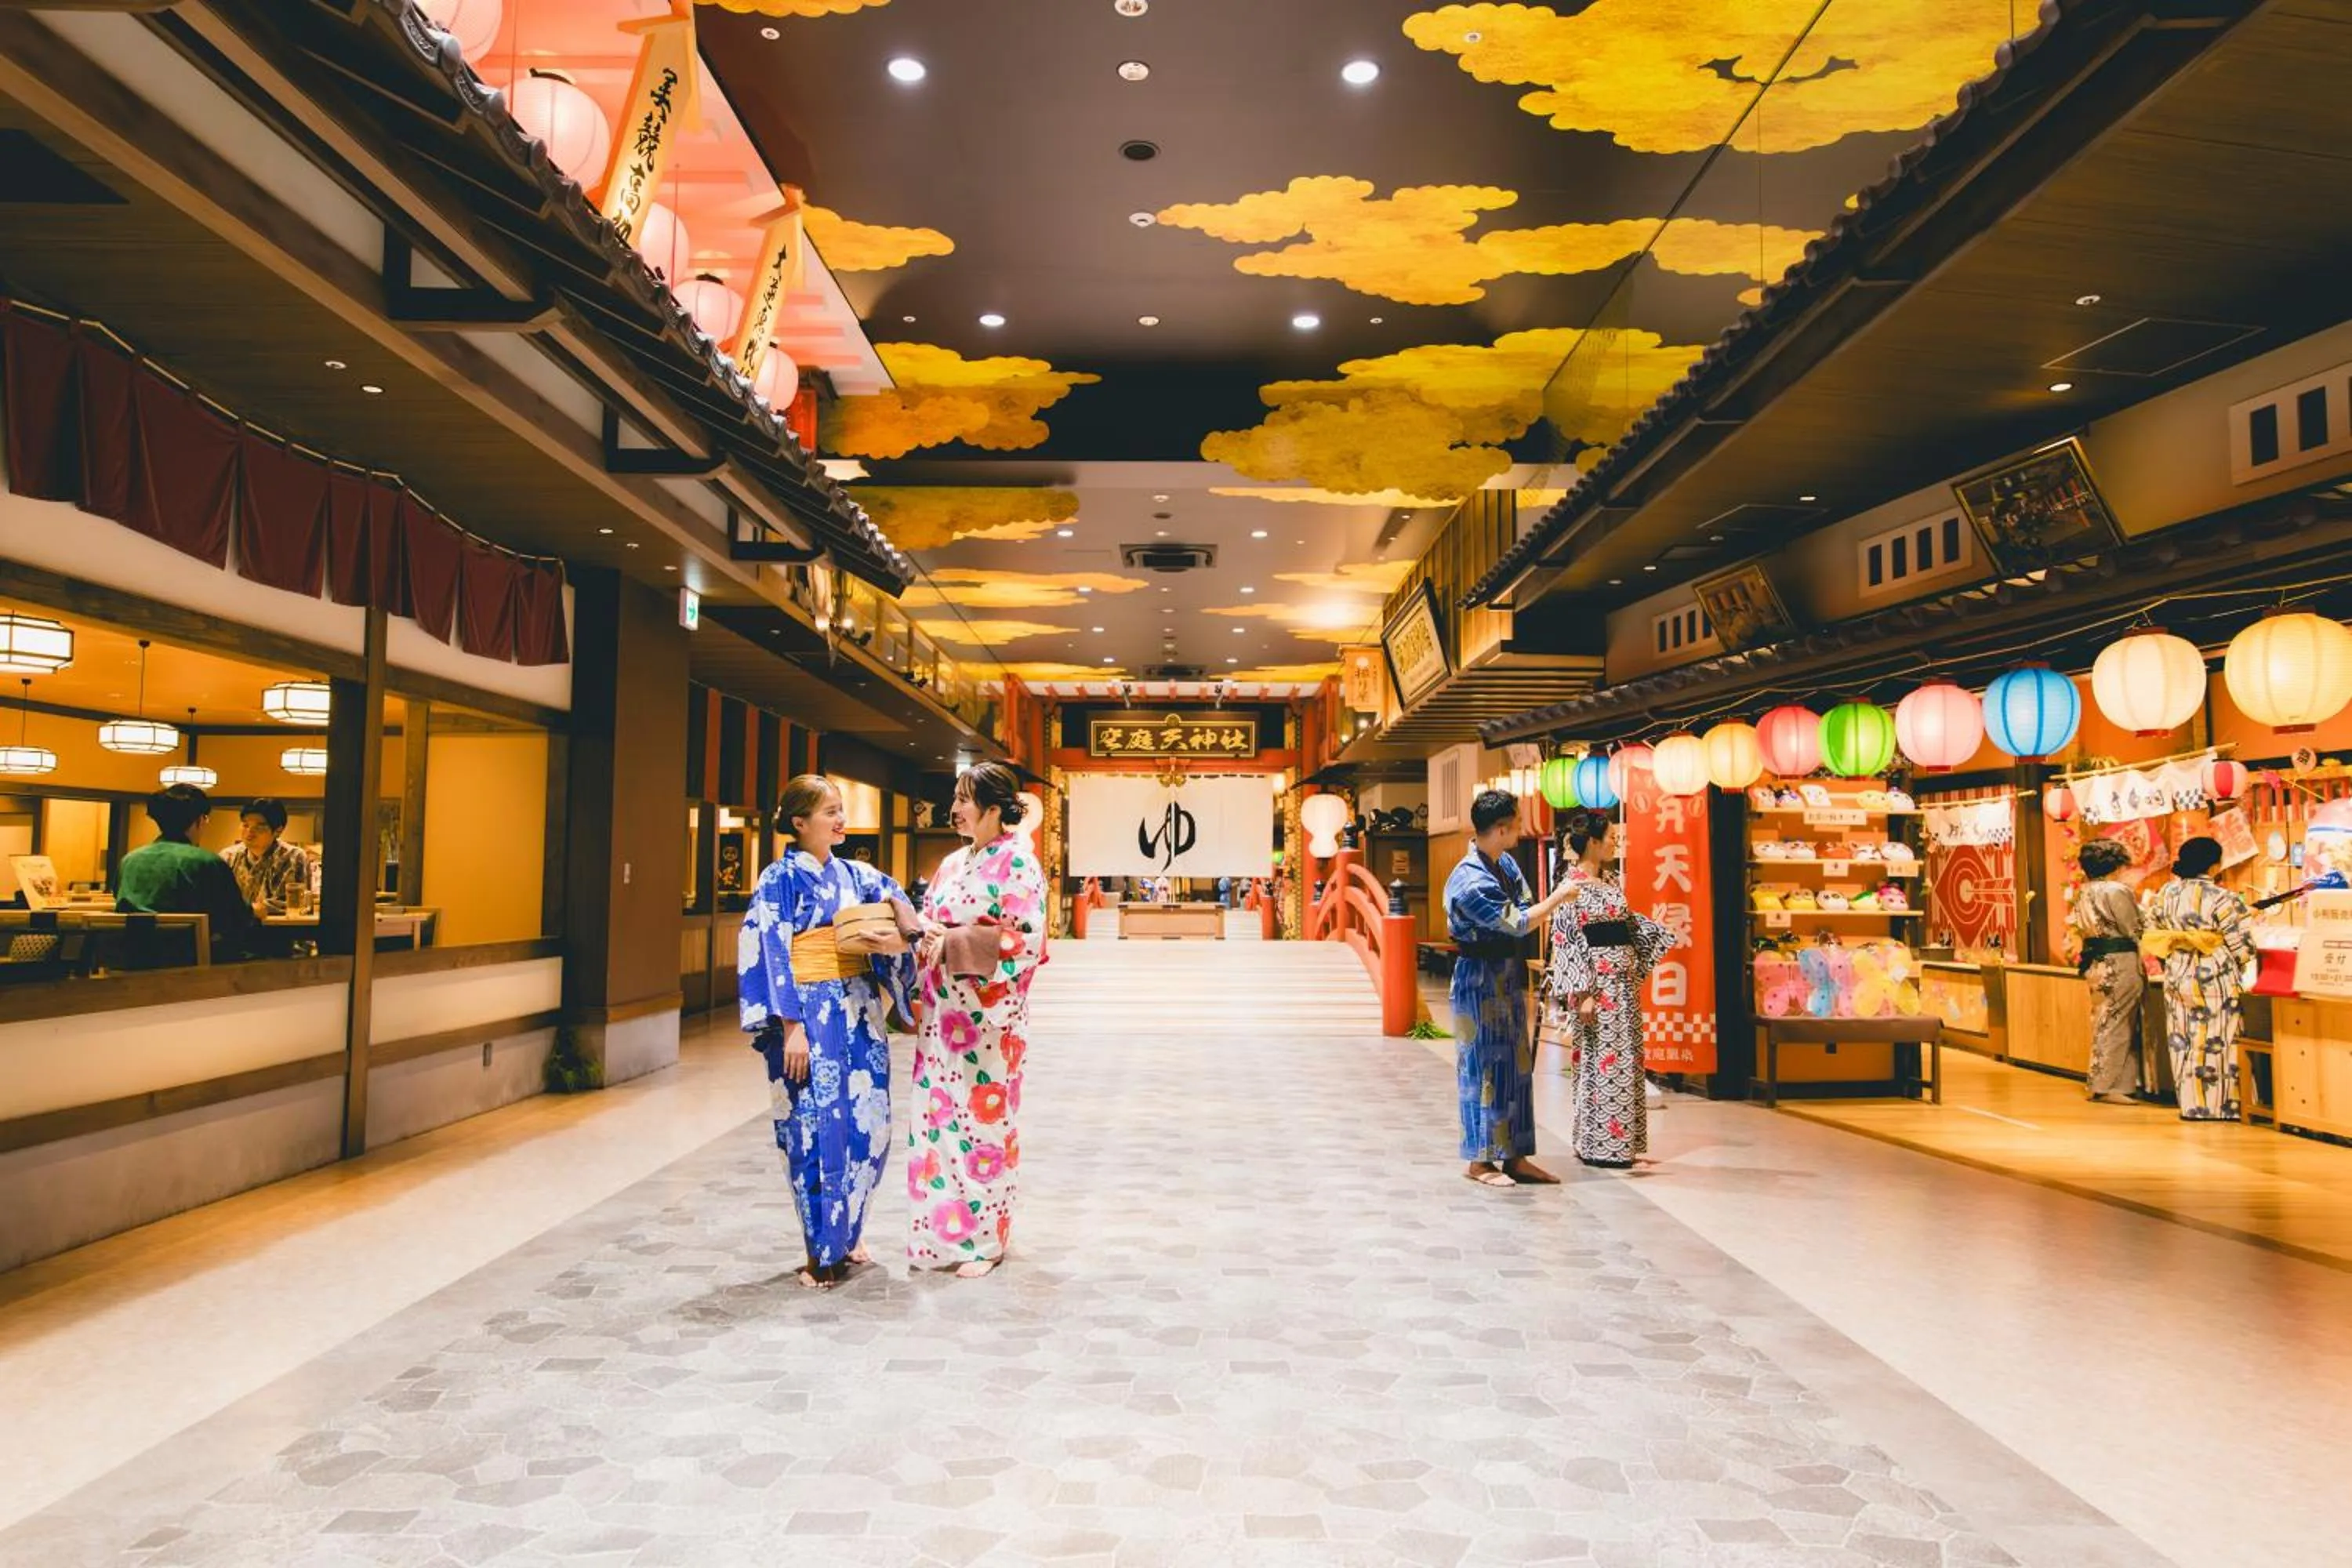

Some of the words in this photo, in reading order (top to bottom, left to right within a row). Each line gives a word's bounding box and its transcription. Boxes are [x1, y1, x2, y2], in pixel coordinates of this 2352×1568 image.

[1098, 728, 1249, 750] 空庭天神社
[1138, 800, 1196, 872] ゆ
